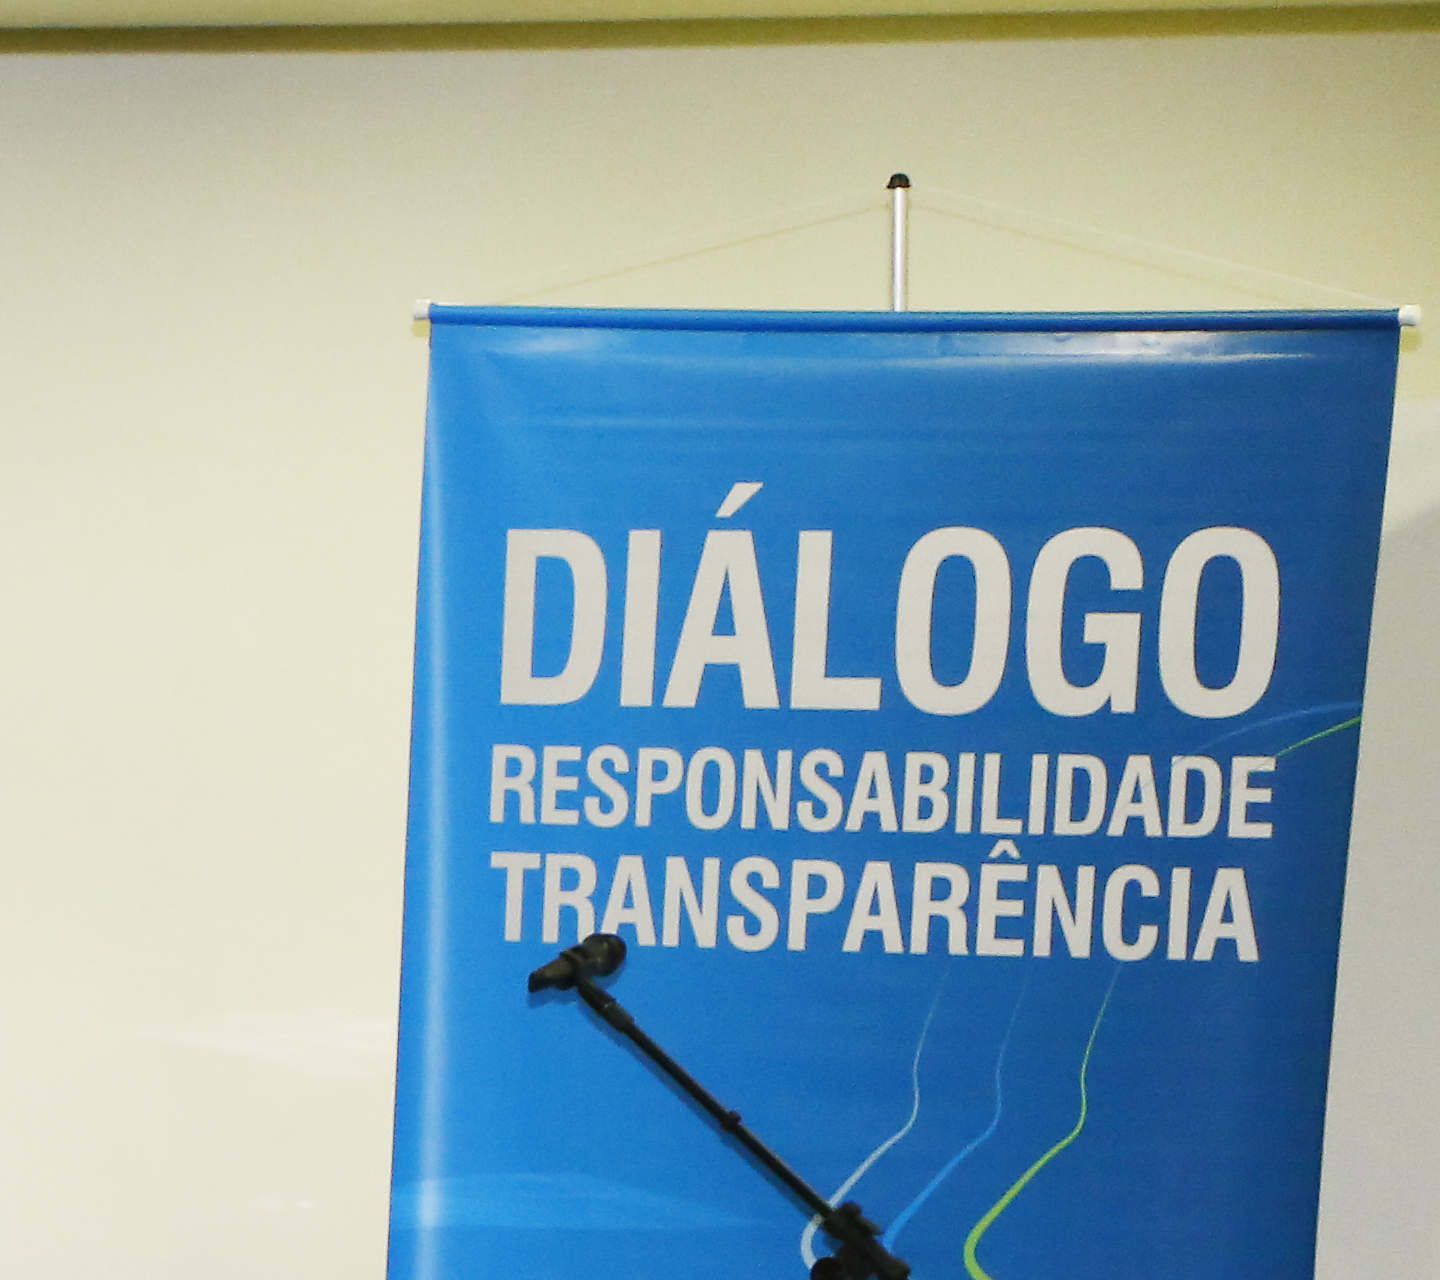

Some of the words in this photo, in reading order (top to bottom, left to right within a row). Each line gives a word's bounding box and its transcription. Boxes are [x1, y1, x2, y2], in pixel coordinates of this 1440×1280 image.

[499, 481, 1281, 719] DIÁLOGO
[488, 743, 1277, 840] RESPONSABILIDADE
[490, 839, 1260, 964] TRANSPARÊNCIA
